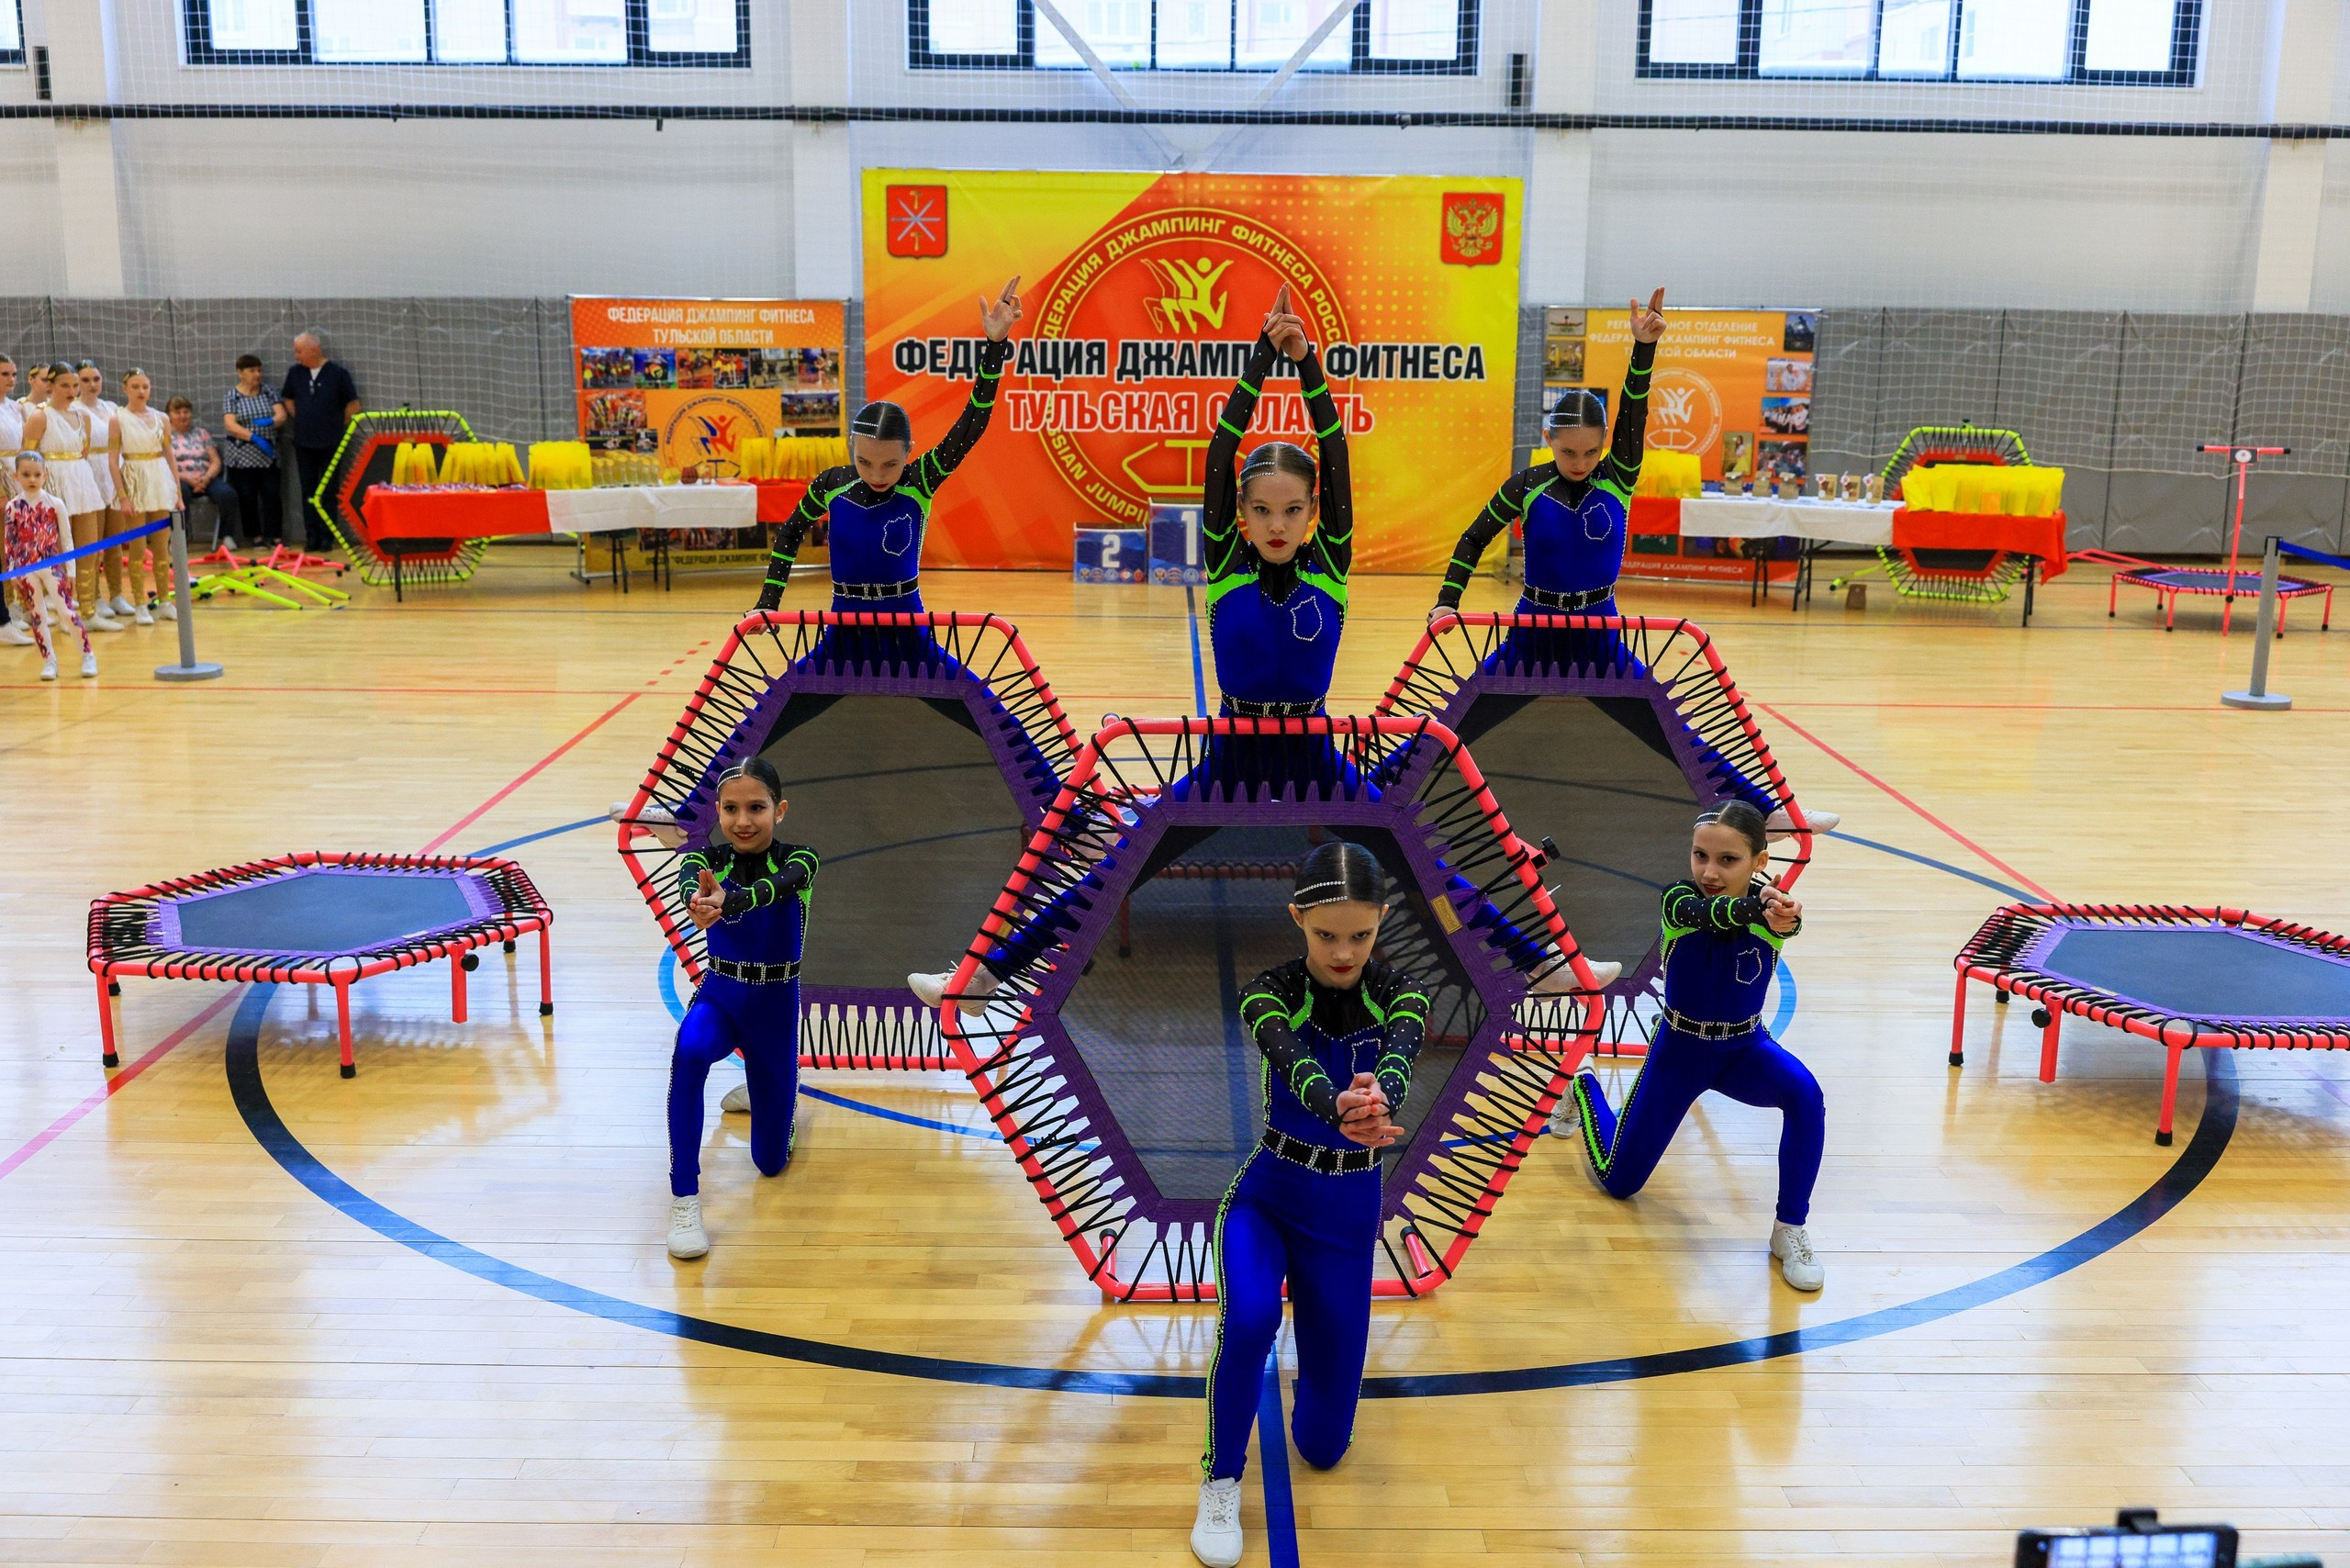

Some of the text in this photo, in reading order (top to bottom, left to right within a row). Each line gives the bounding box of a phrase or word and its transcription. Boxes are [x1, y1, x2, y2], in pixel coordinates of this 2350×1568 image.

[1043, 216, 1342, 342] ДЕРАЦИЯ ДЖАМПИНГ ФИТНЕСА РОСС
[607, 307, 815, 324] ФЕДЕРАЦИЯ ДЖАМПИНГ ФИТНЕСА
[1607, 319, 1759, 332] РЕГИНОЕ ОТДЕЛЕНИЕ
[653, 327, 774, 344] ТУЛЬСКОЙ ОБЛАСТИ
[1589, 332, 1636, 343] ФЕДЕРА
[1724, 336, 1775, 346] ФИТНЕСА
[1684, 347, 1737, 359] ОБЛАСТИ
[1114, 341, 1318, 384] ДЖАМПН
[1326, 342, 1486, 381] ФИТНЕСА
[1006, 390, 1375, 435] ТУЛЬСКАЯ ОЛАТЬ
[1085, 482, 1149, 523] JUMPI
[1102, 533, 1121, 568] 2
[1181, 510, 1198, 566] 1
